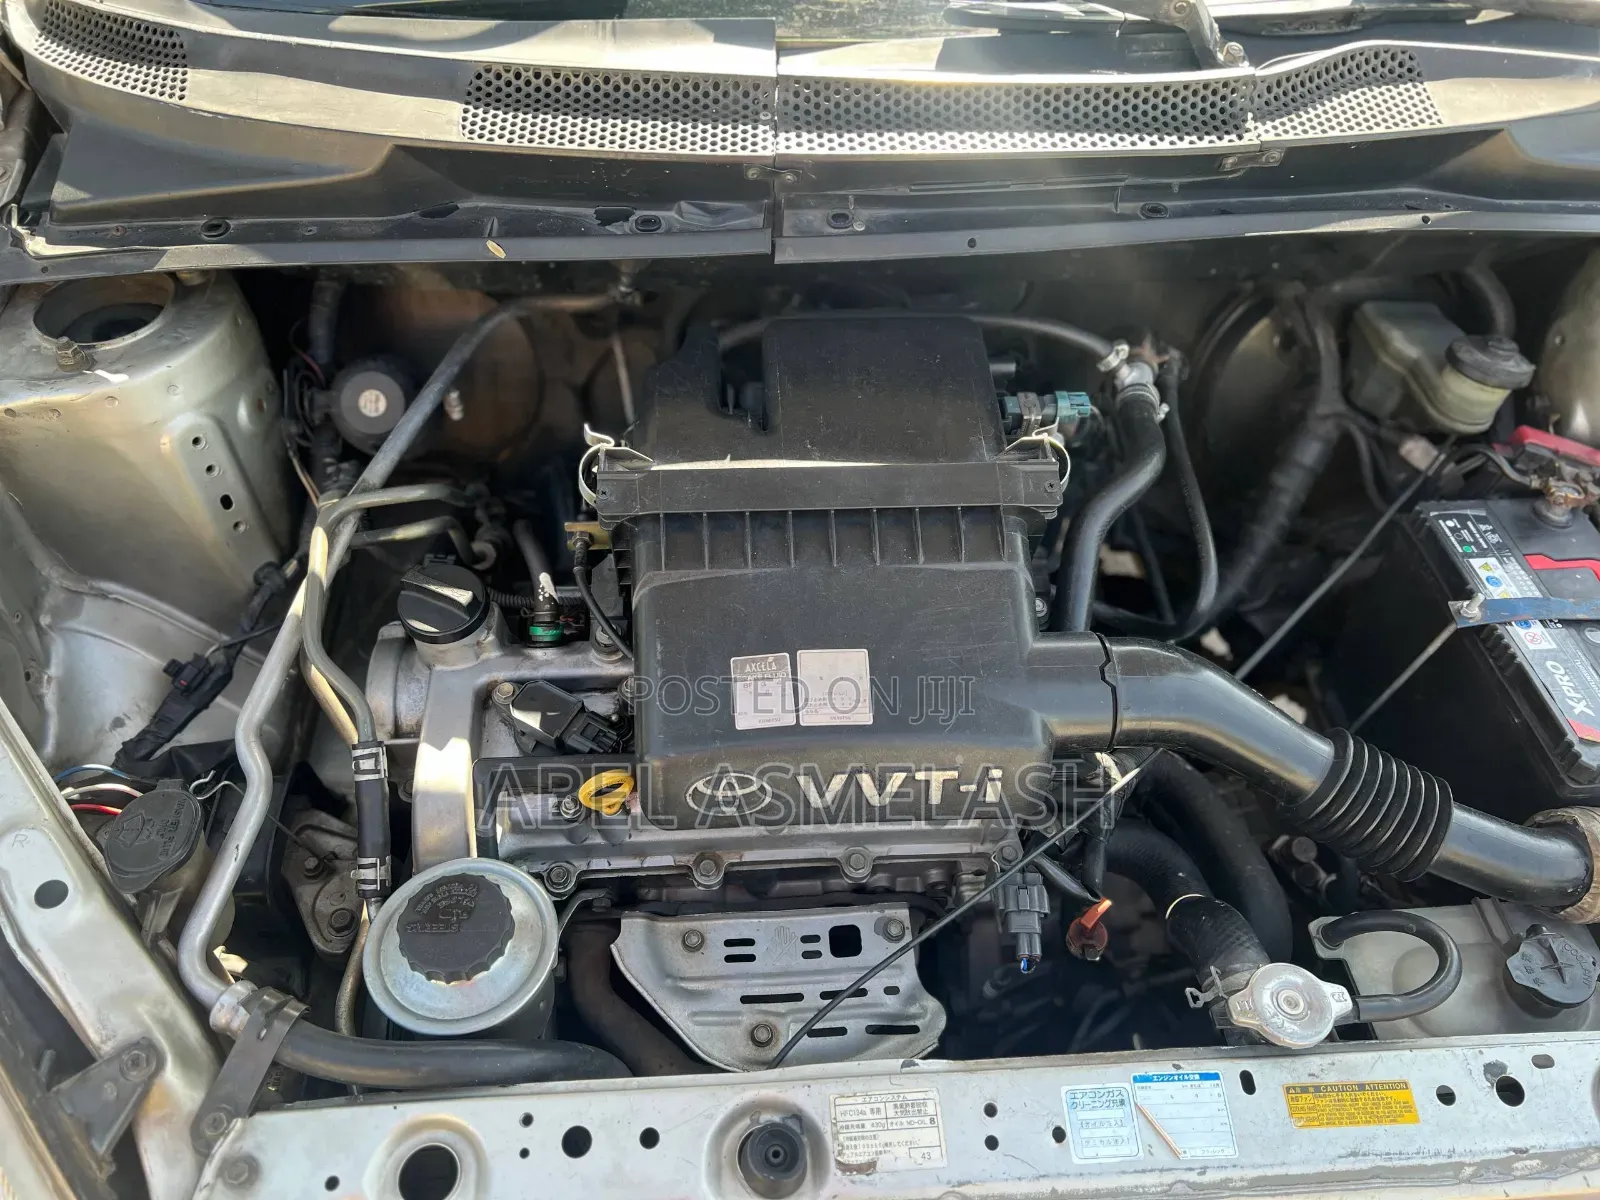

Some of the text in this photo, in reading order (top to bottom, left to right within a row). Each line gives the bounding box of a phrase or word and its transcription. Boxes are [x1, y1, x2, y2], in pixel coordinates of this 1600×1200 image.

[745, 661, 777, 674] AXCELA
[795, 768, 1003, 809] VVT-i
[1320, 1082, 1406, 1093] CAUTION ATTENTION
[861, 1094, 908, 1103] エアコンシステム
[1069, 1089, 1125, 1100] エアコンガス
[870, 1121, 886, 1129] 430g
[929, 1117, 936, 1125] 8
[920, 1151, 932, 1160] 43
